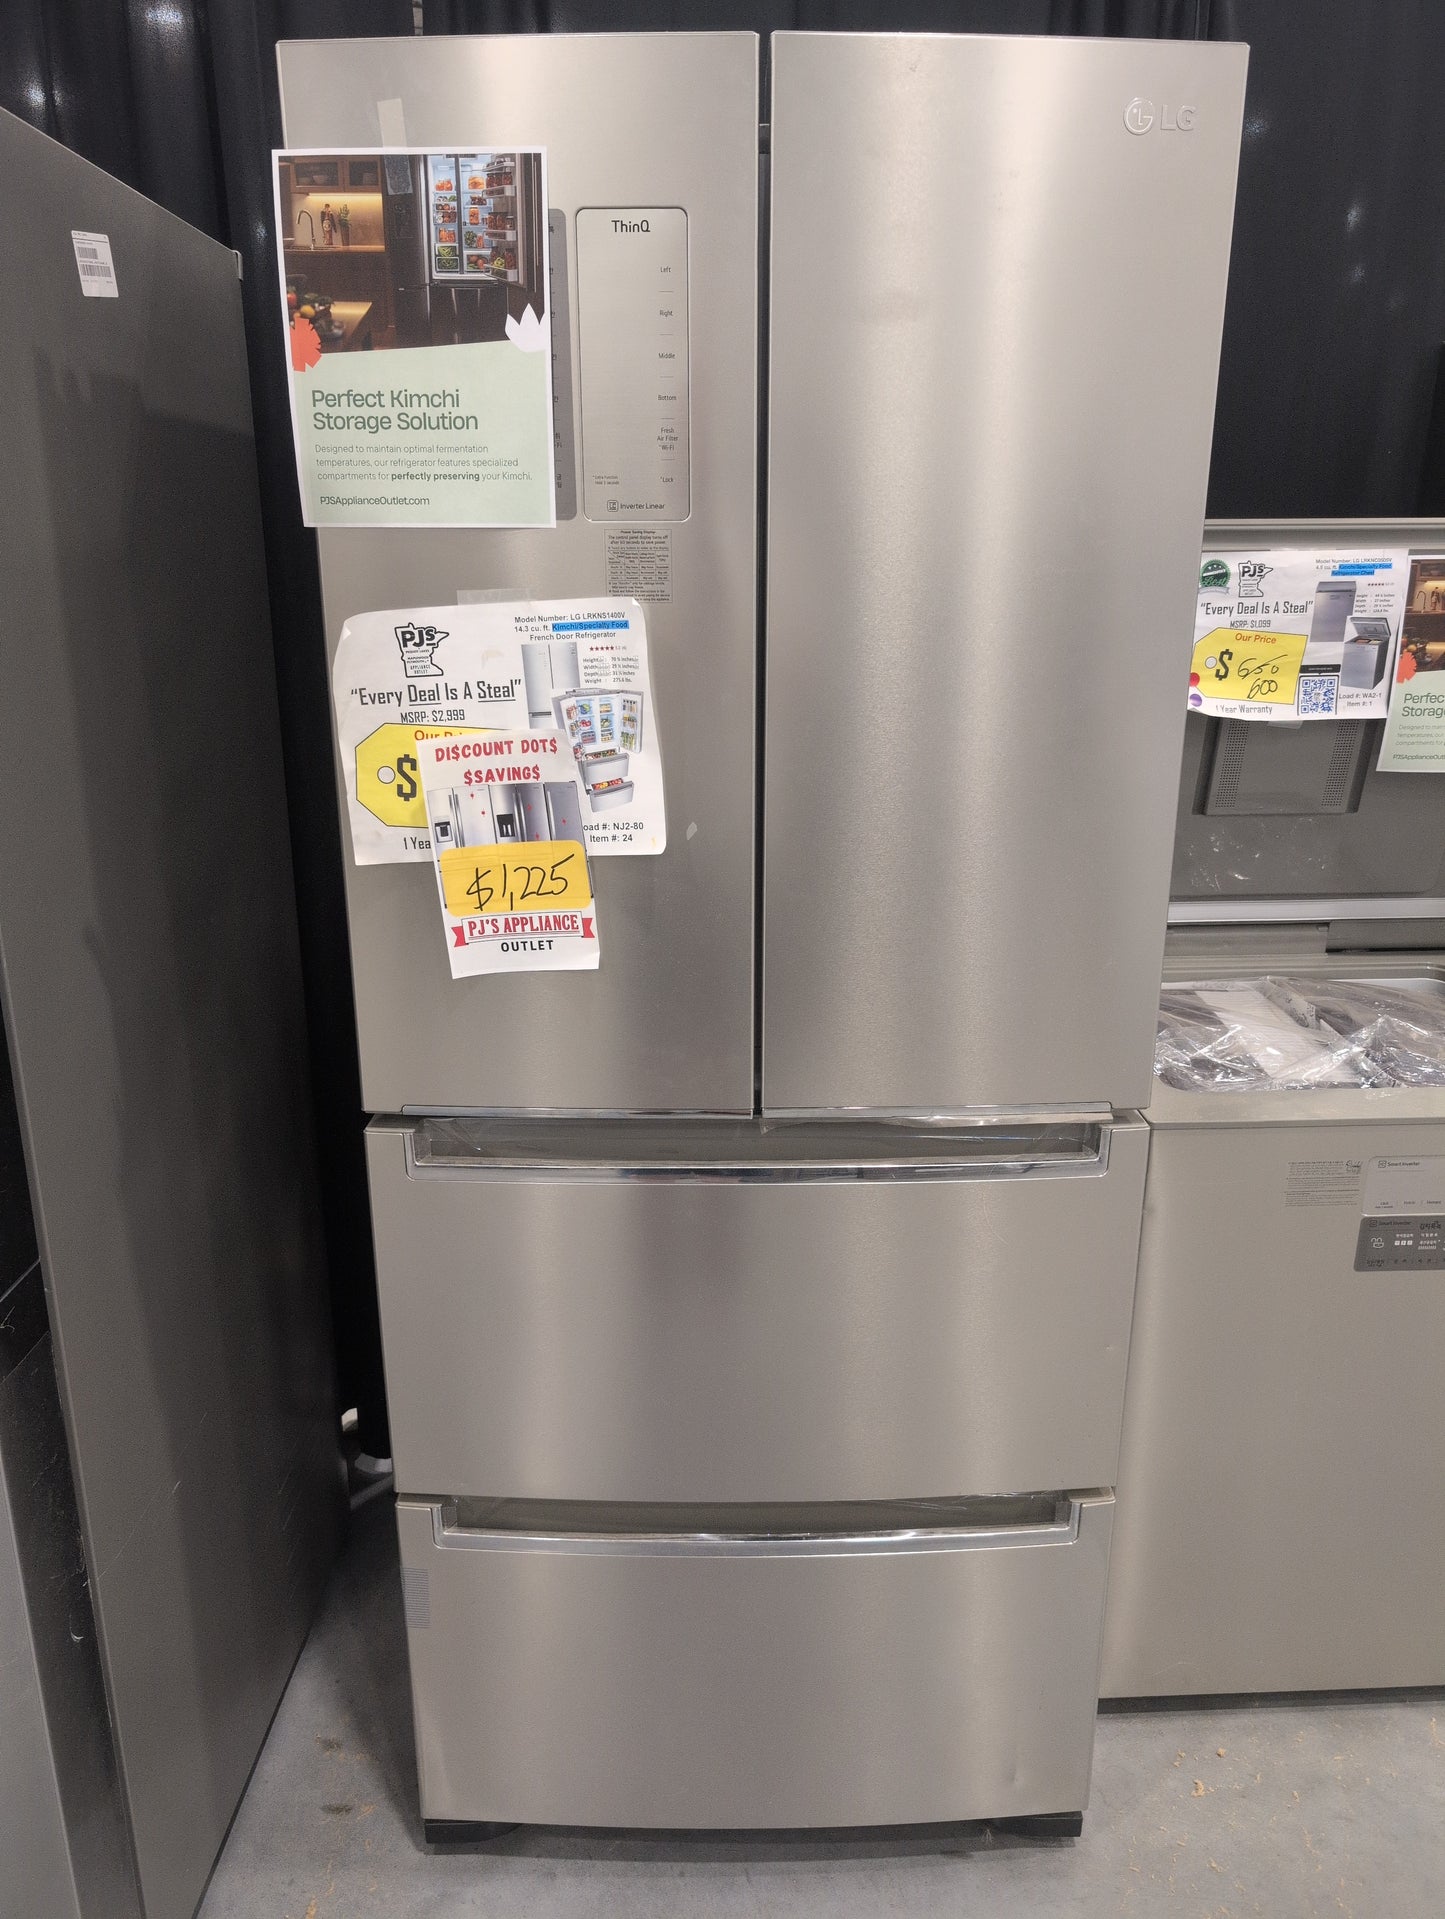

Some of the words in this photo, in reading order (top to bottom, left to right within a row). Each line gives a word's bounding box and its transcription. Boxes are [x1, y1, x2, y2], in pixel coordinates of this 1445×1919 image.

[611, 219, 651, 233] ThinQ
[659, 310, 673, 318] Right
[311, 389, 385, 408] Perfect
[390, 389, 460, 408] Kimchi
[313, 412, 392, 434] Storage
[397, 412, 479, 431] Solution
[315, 444, 354, 455] Designed
[356, 445, 365, 453] to
[366, 445, 402, 453] maintain
[403, 444, 435, 455] optimal
[436, 445, 489, 453] fermentation
[316, 459, 373, 468] temperatures,
[390, 458, 436, 469] refrigerator
[437, 458, 470, 467] features
[472, 458, 519, 469] specialized
[317, 472, 377, 482] compartments
[378, 471, 389, 480] for
[391, 471, 431, 482] perfectly
[433, 471, 480, 482] preserving
[481, 473, 500, 482] your
[502, 471, 533, 480] Kimchi.
[320, 496, 430, 507] PJSApplianceOutlet.com
[1237, 601, 1258, 615] Deal
[1261, 601, 1270, 614] Is
[1273, 600, 1280, 614] A
[514, 616, 537, 624] Model
[537, 614, 569, 622] Number:
[570, 613, 581, 621] LG
[582, 611, 626, 620] LRKNS1400V
[1229, 620, 1249, 628] MSRP:
[1250, 620, 1271, 628] $1,099
[552, 621, 610, 632] Kimchi/Specialty
[611, 621, 628, 629] Food
[529, 633, 554, 641] French
[575, 631, 617, 641] Refrigerator
[1235, 632, 1252, 642] Our
[1254, 634, 1277, 644] Price
[1214, 648, 1234, 681] $
[351, 687, 403, 707] “Every
[407, 682, 441, 703] Deal
[444, 682, 458, 701] Is
[463, 681, 474, 700] A
[477, 678, 522, 700] Steal”
[1403, 692, 1445, 704] Perfec
[400, 711, 430, 724] MSRP:
[431, 709, 466, 723] $2,999
[1219, 705, 1238, 713] Year
[1239, 705, 1273, 715] Warranty
[1401, 706, 1445, 719] Storag
[435, 740, 514, 763] DI$COUNT
[521, 737, 558, 755] DOT$
[396, 753, 418, 802] $
[463, 764, 541, 787] $SAVING$
[583, 823, 600, 831] oad
[601, 822, 610, 831] #:
[613, 821, 644, 831] NJ2-80
[403, 837, 408, 850] 1
[410, 836, 432, 850] Yea
[589, 834, 609, 843] Item
[611, 833, 620, 842] #:
[622, 833, 633, 842] 24
[466, 853, 575, 912] $1,225
[468, 919, 500, 937] PJ'S
[503, 914, 580, 934] APPLIANCE
[500, 939, 554, 953] OUTLET
